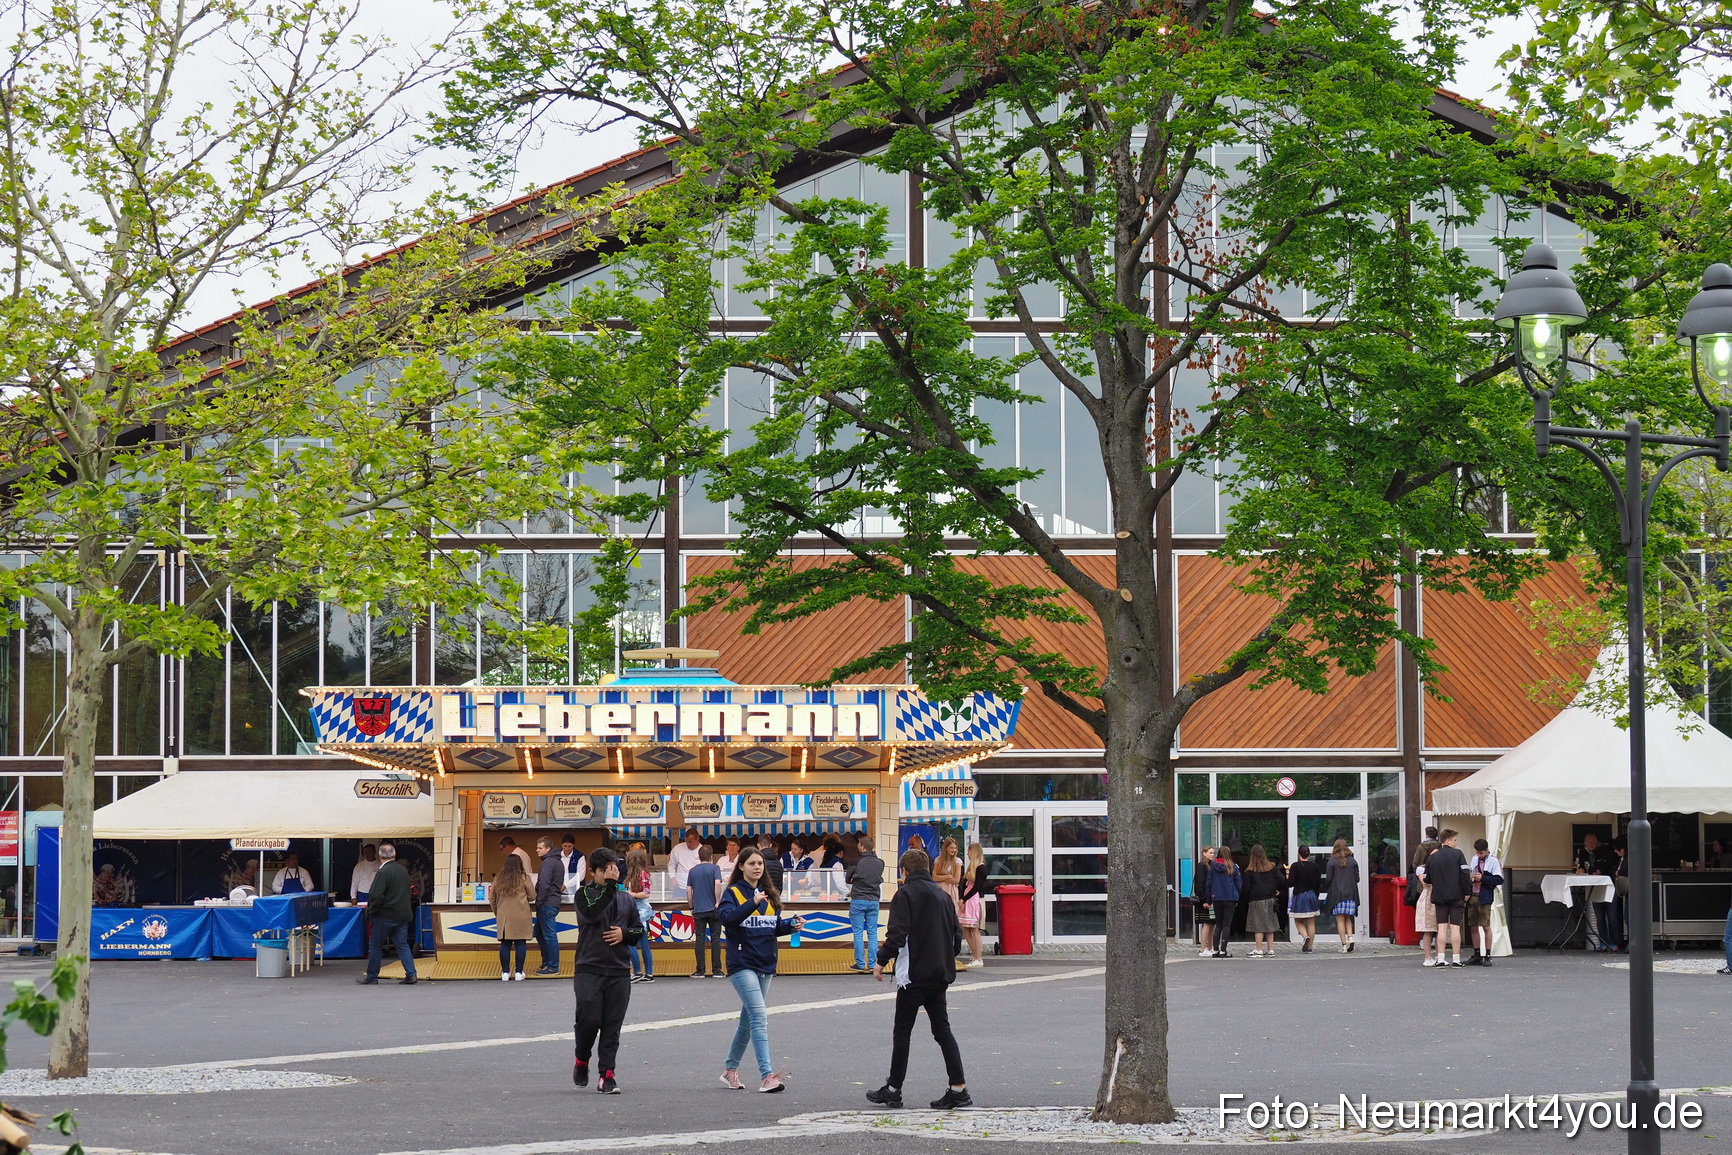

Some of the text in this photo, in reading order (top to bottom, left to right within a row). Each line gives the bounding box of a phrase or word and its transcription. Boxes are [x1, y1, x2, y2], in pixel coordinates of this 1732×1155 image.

[441, 694, 879, 737] Liebermann
[360, 782, 414, 796] Schaschlik
[920, 782, 974, 796] Pommesfrites
[1134, 786, 1143, 795] 18
[489, 795, 506, 804] Steak
[558, 797, 583, 806] Frikadelle
[626, 795, 655, 804] Bockwurst
[747, 795, 778, 805] Currywurst
[235, 838, 285, 849] Pfandrückgabe
[98, 842, 139, 865] Liebermann
[745, 916, 776, 927] ellesse
